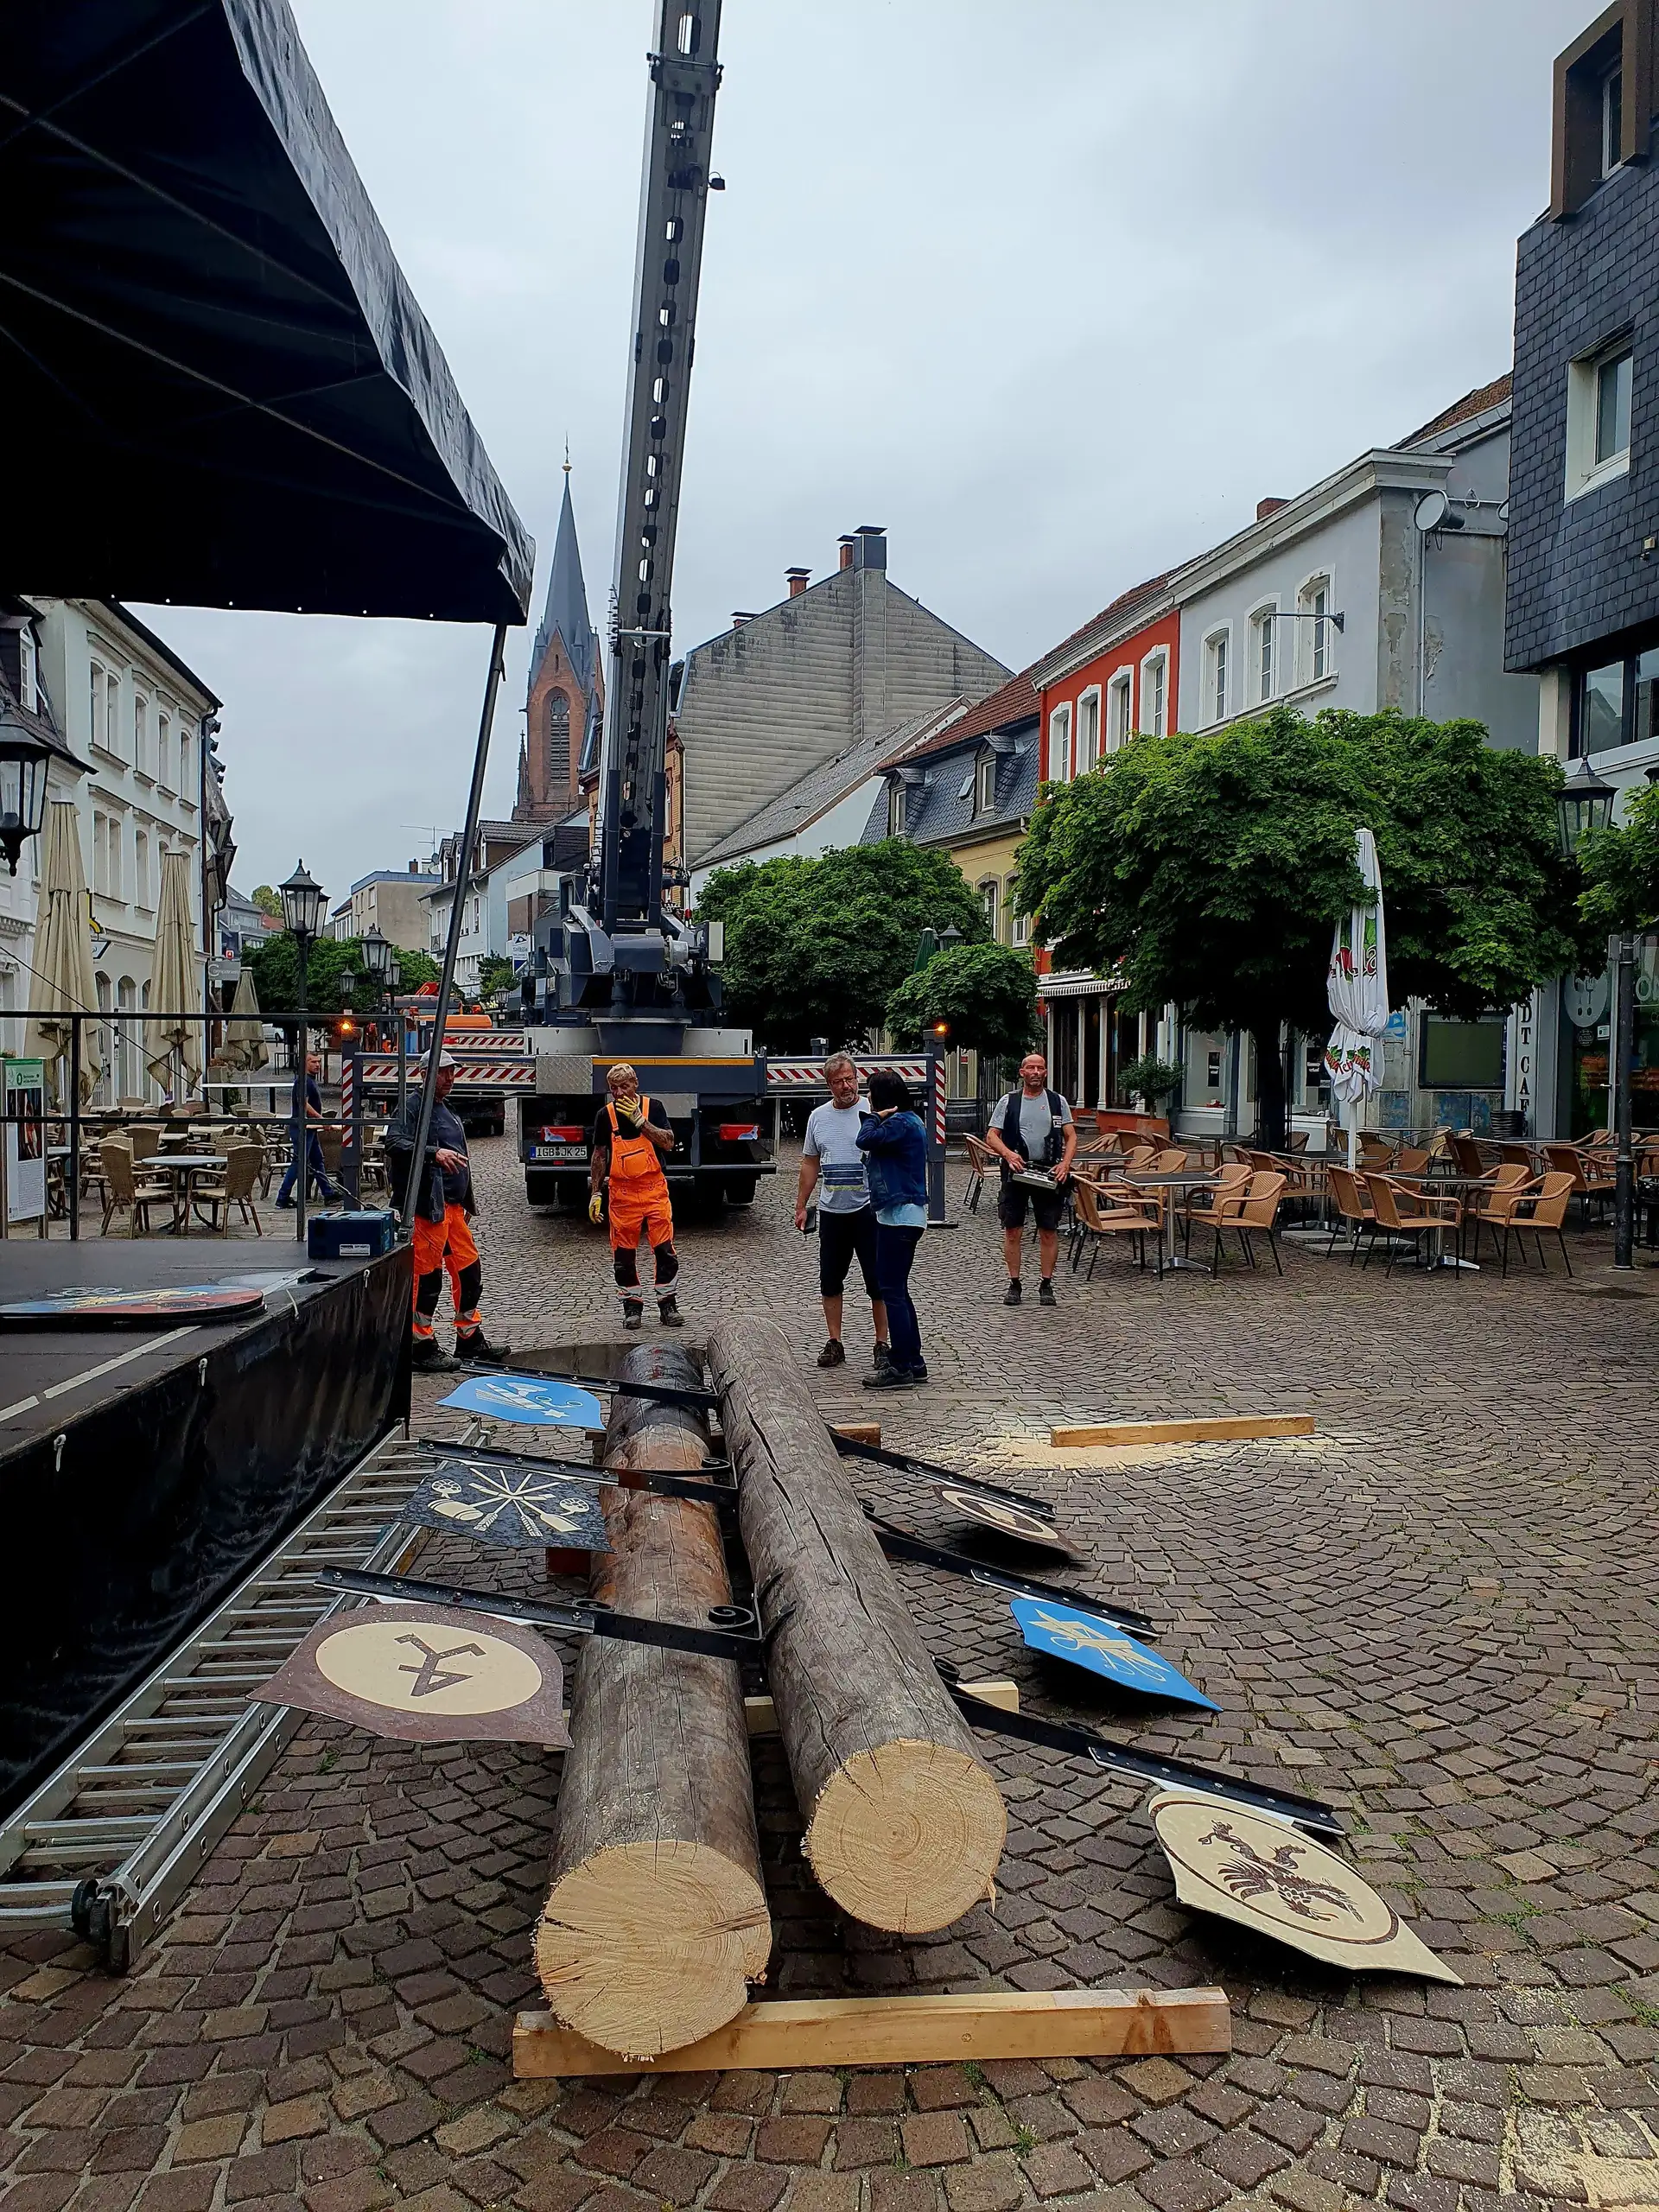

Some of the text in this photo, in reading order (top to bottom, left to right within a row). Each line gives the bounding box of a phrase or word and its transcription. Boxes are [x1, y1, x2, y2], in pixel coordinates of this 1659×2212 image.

[537, 1147, 586, 1157] IGB JK 25
